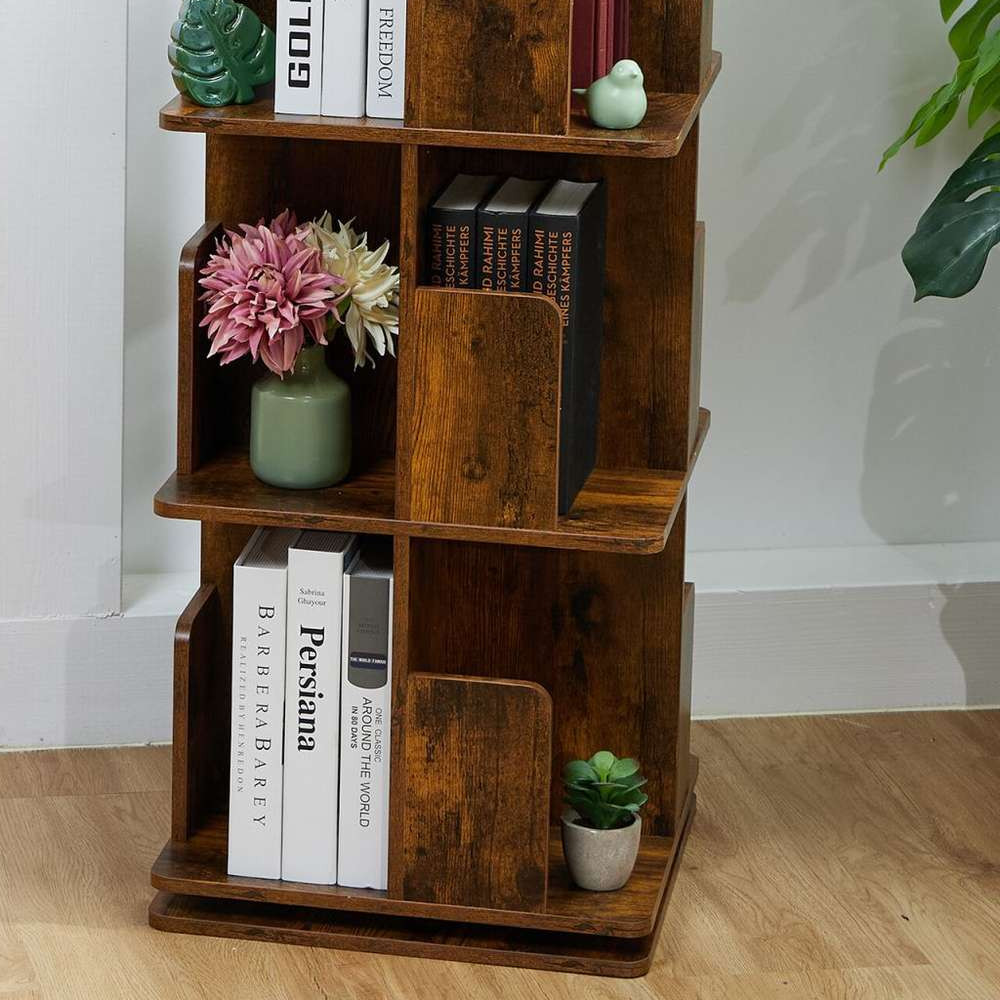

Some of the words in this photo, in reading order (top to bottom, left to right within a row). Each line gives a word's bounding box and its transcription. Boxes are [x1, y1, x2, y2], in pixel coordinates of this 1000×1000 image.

[378, 8, 393, 98] FREEDOM
[445, 225, 456, 288] ESCHICHTE
[482, 226, 494, 273] RAHIMI
[497, 227, 508, 292] ESCHICHTE
[533, 229, 545, 276] RAHIMI
[297, 624, 325, 751] Persiana
[351, 706, 359, 715] IN
[350, 727, 358, 749] DAYS
[351, 716, 358, 726] 80
[361, 697, 373, 751] AROUND
[360, 754, 371, 778] THE
[374, 729, 382, 762] CLASSIC
[360, 782, 371, 828] WORLD
